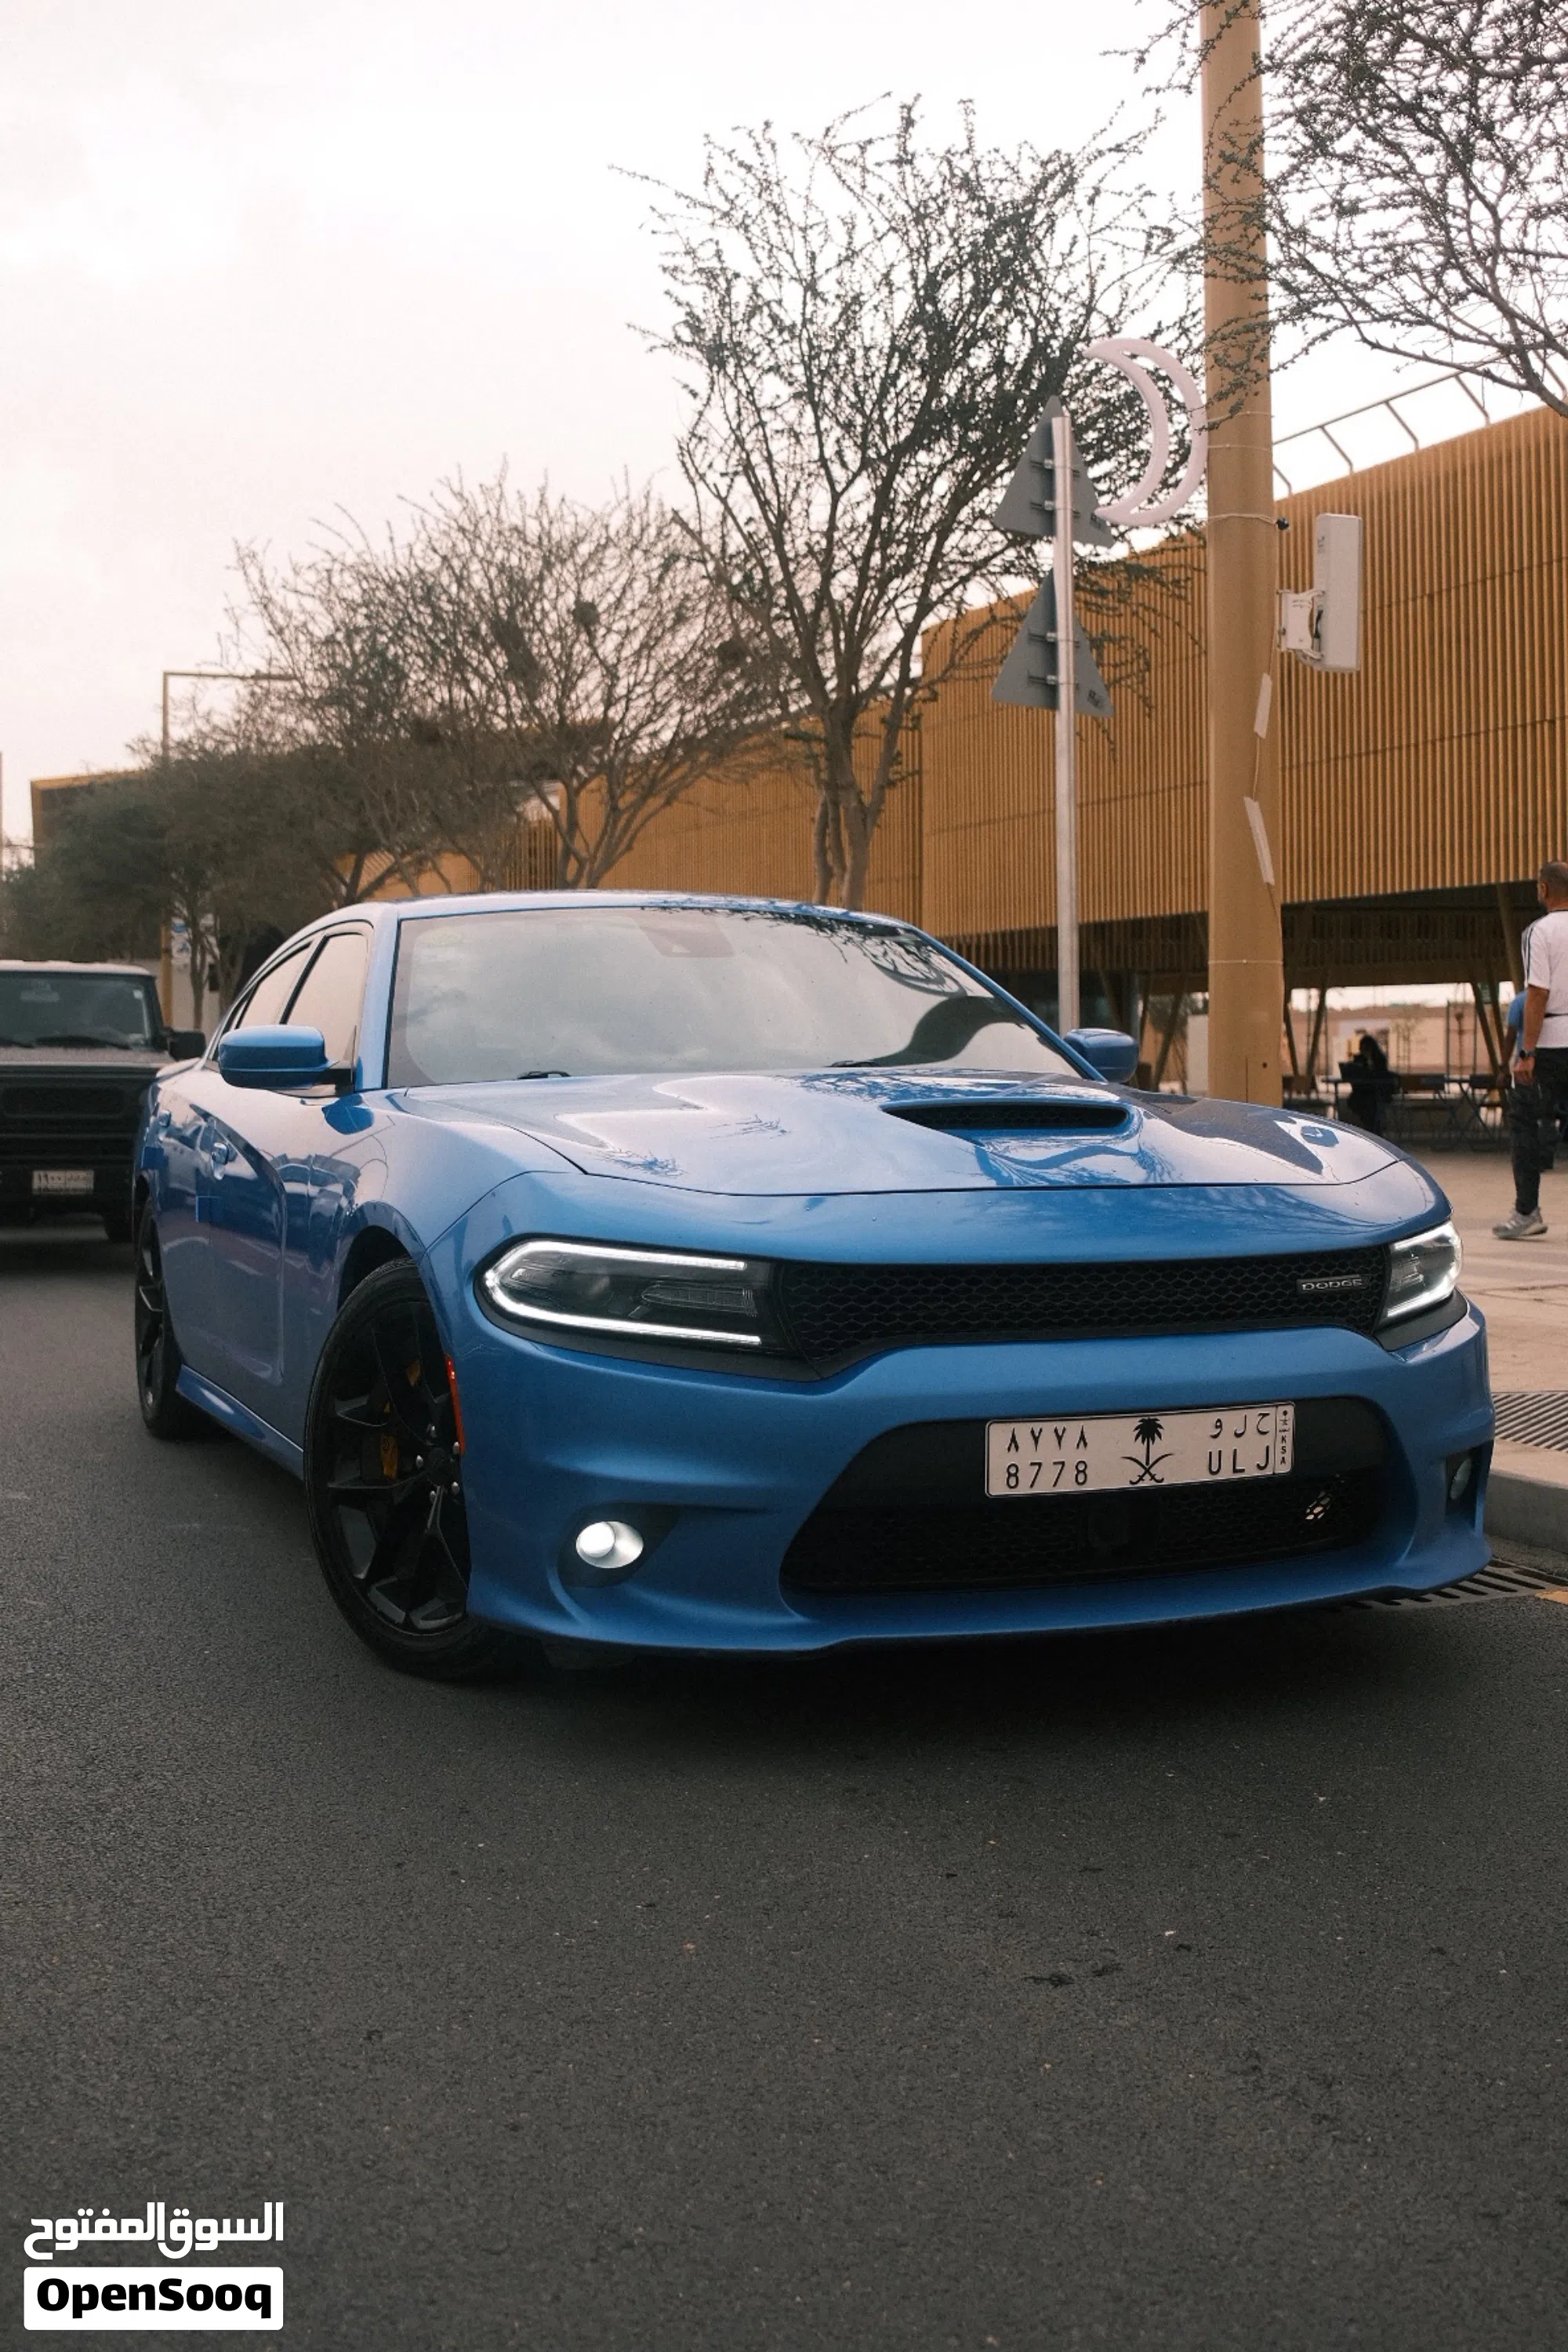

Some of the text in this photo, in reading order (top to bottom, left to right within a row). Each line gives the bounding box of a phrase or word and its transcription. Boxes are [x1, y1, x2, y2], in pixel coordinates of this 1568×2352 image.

[1302, 1279, 1363, 1290] DODGE
[1007, 1424, 1087, 1453] ٨٧٧٨
[1006, 1460, 1087, 1490] 8778
